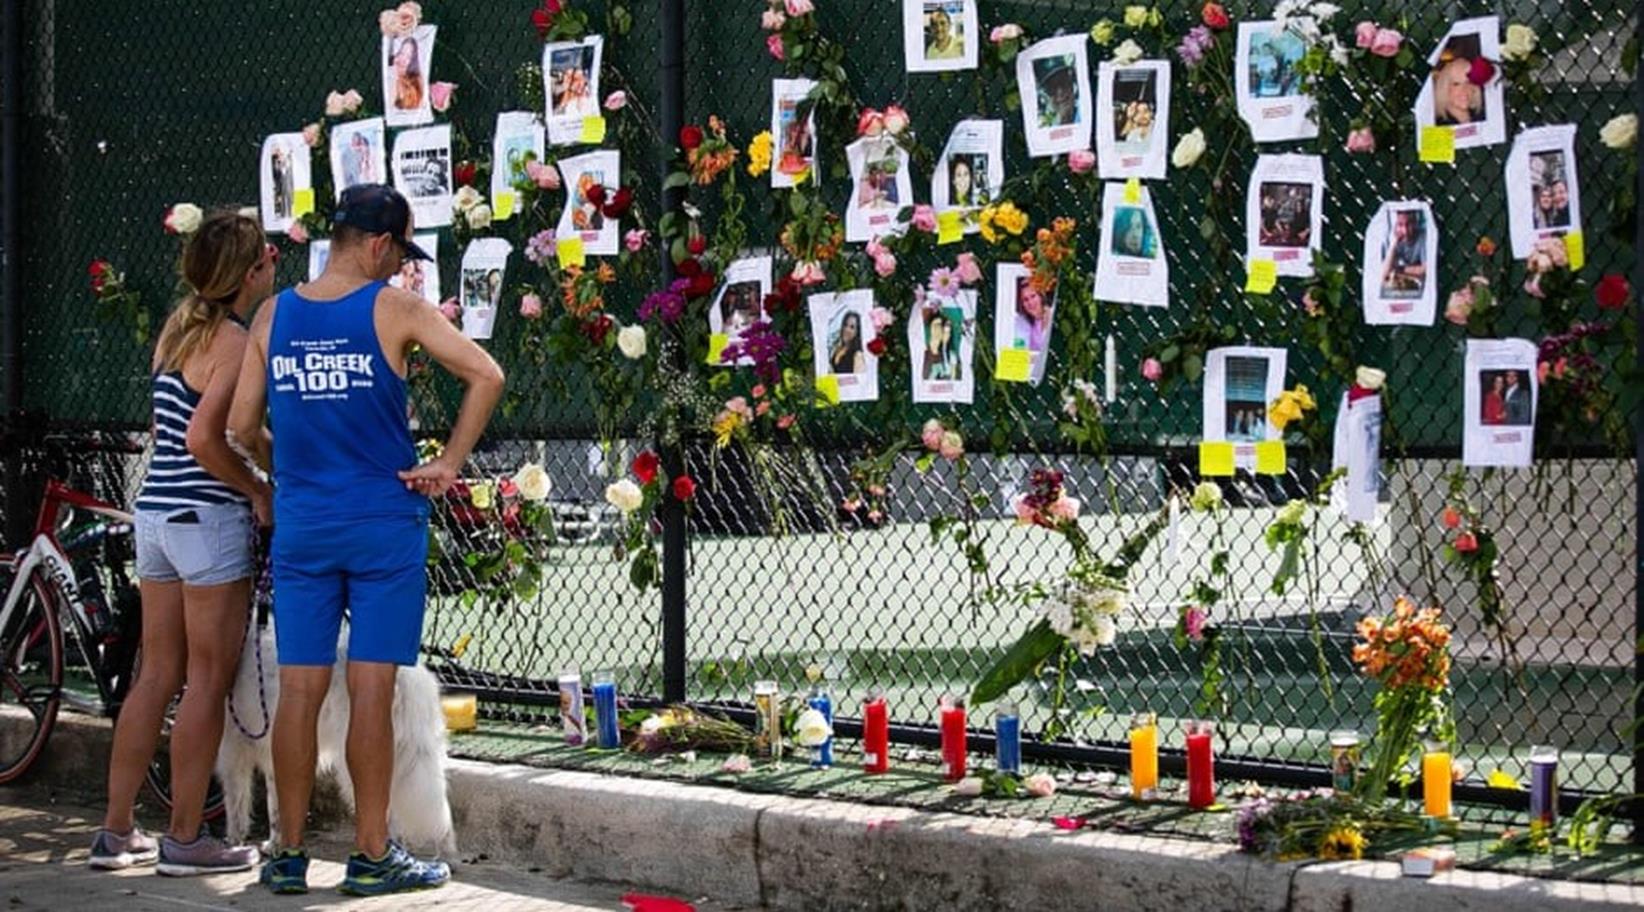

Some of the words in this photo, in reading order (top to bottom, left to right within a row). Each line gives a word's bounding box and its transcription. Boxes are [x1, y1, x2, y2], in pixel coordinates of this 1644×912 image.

[272, 355, 302, 379] OIL
[304, 352, 373, 376] CREEK
[293, 370, 348, 392] 100
